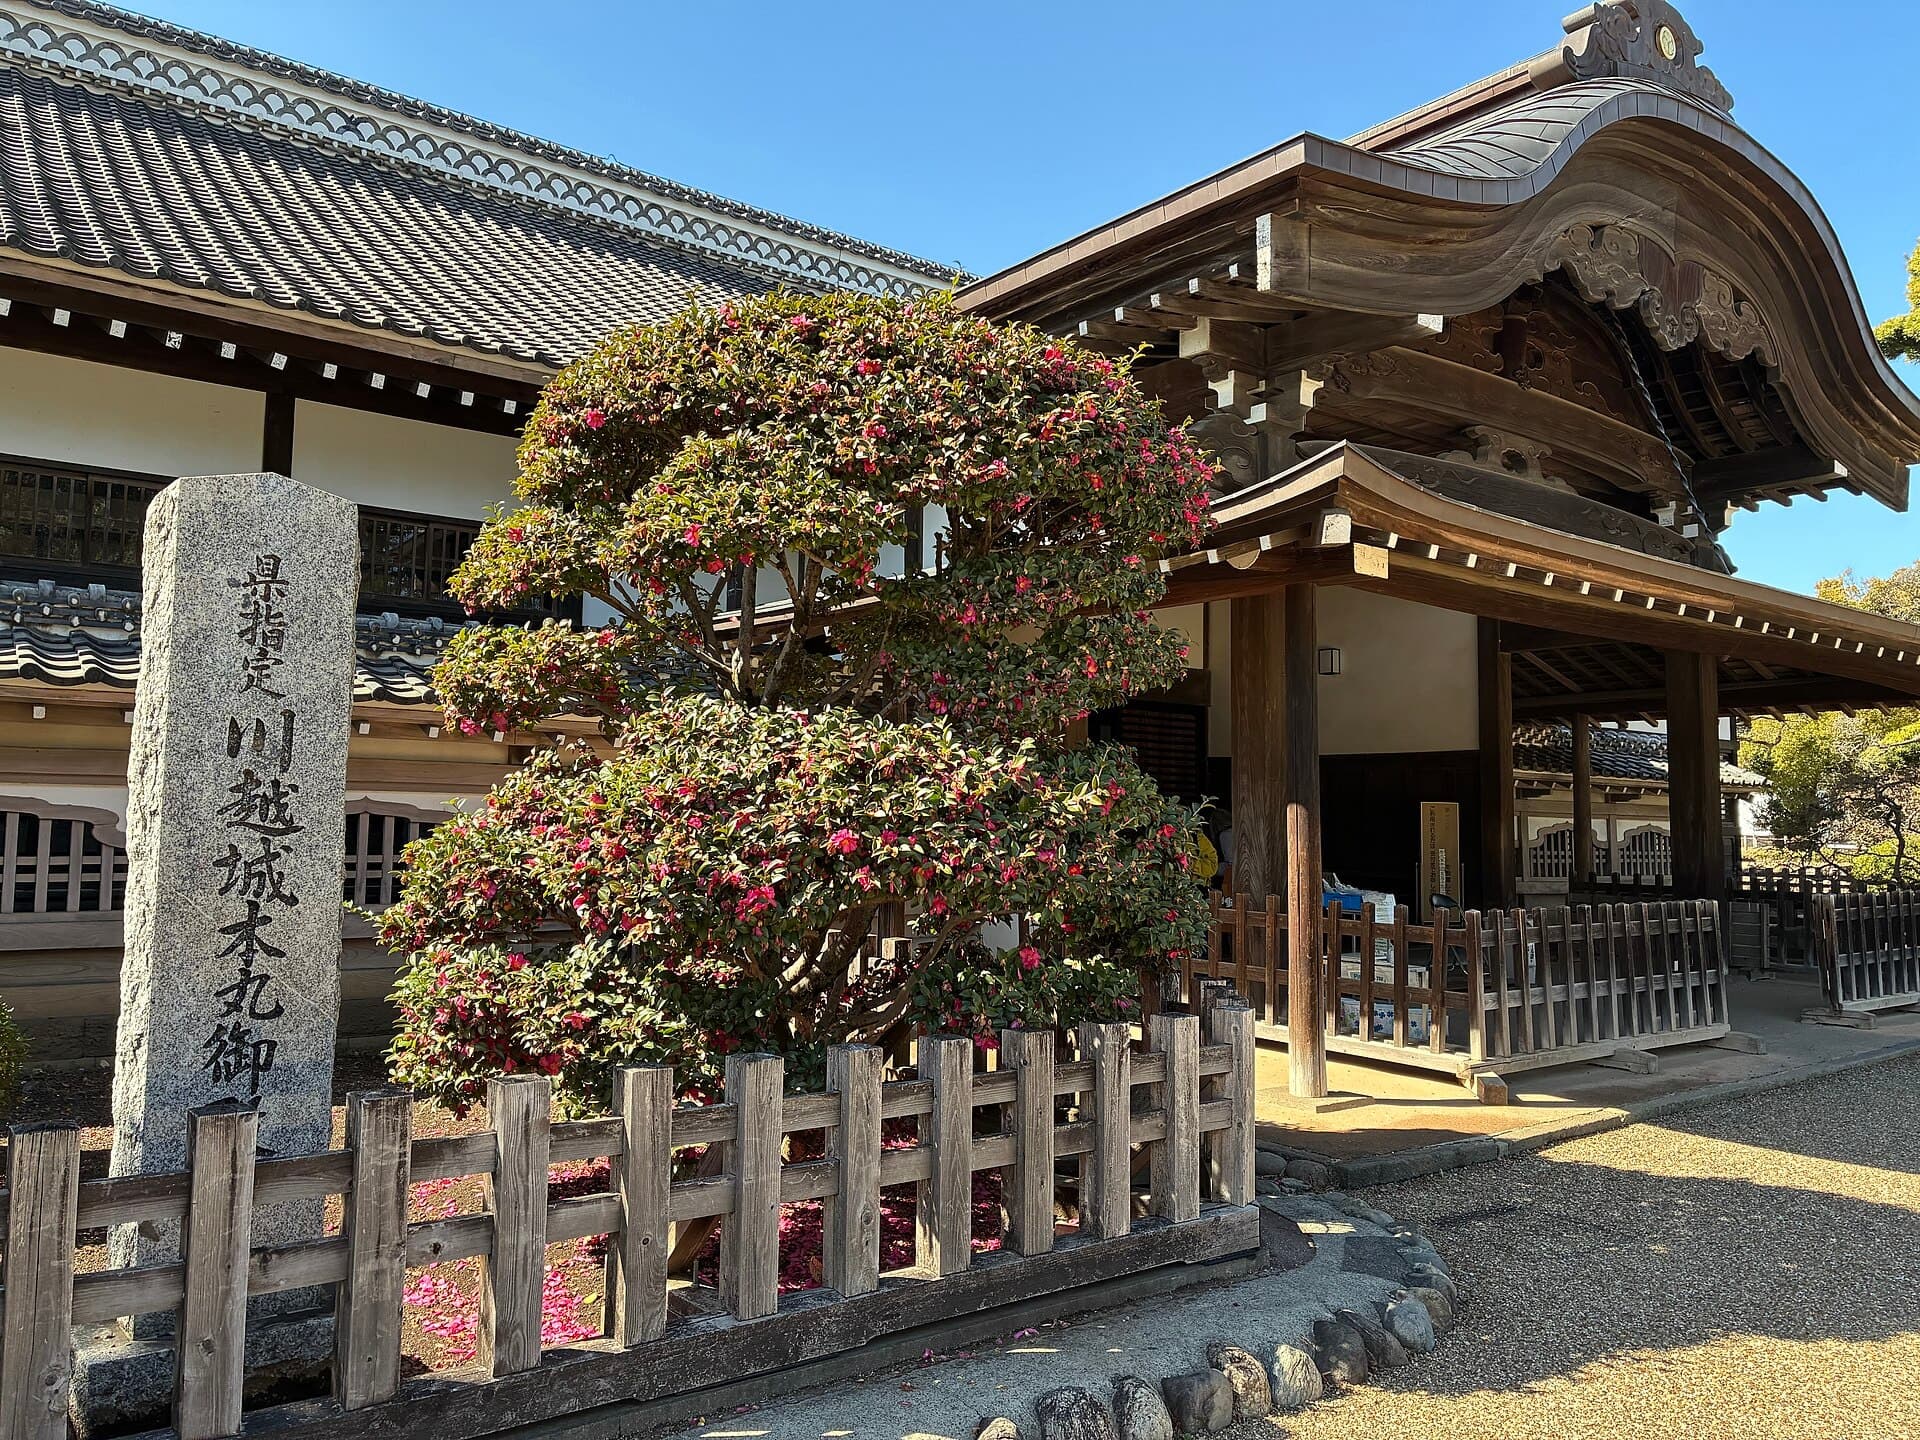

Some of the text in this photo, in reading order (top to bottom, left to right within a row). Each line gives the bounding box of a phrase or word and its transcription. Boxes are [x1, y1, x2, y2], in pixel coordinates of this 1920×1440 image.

[202, 554, 305, 1153] 県指定川越城本丸御
